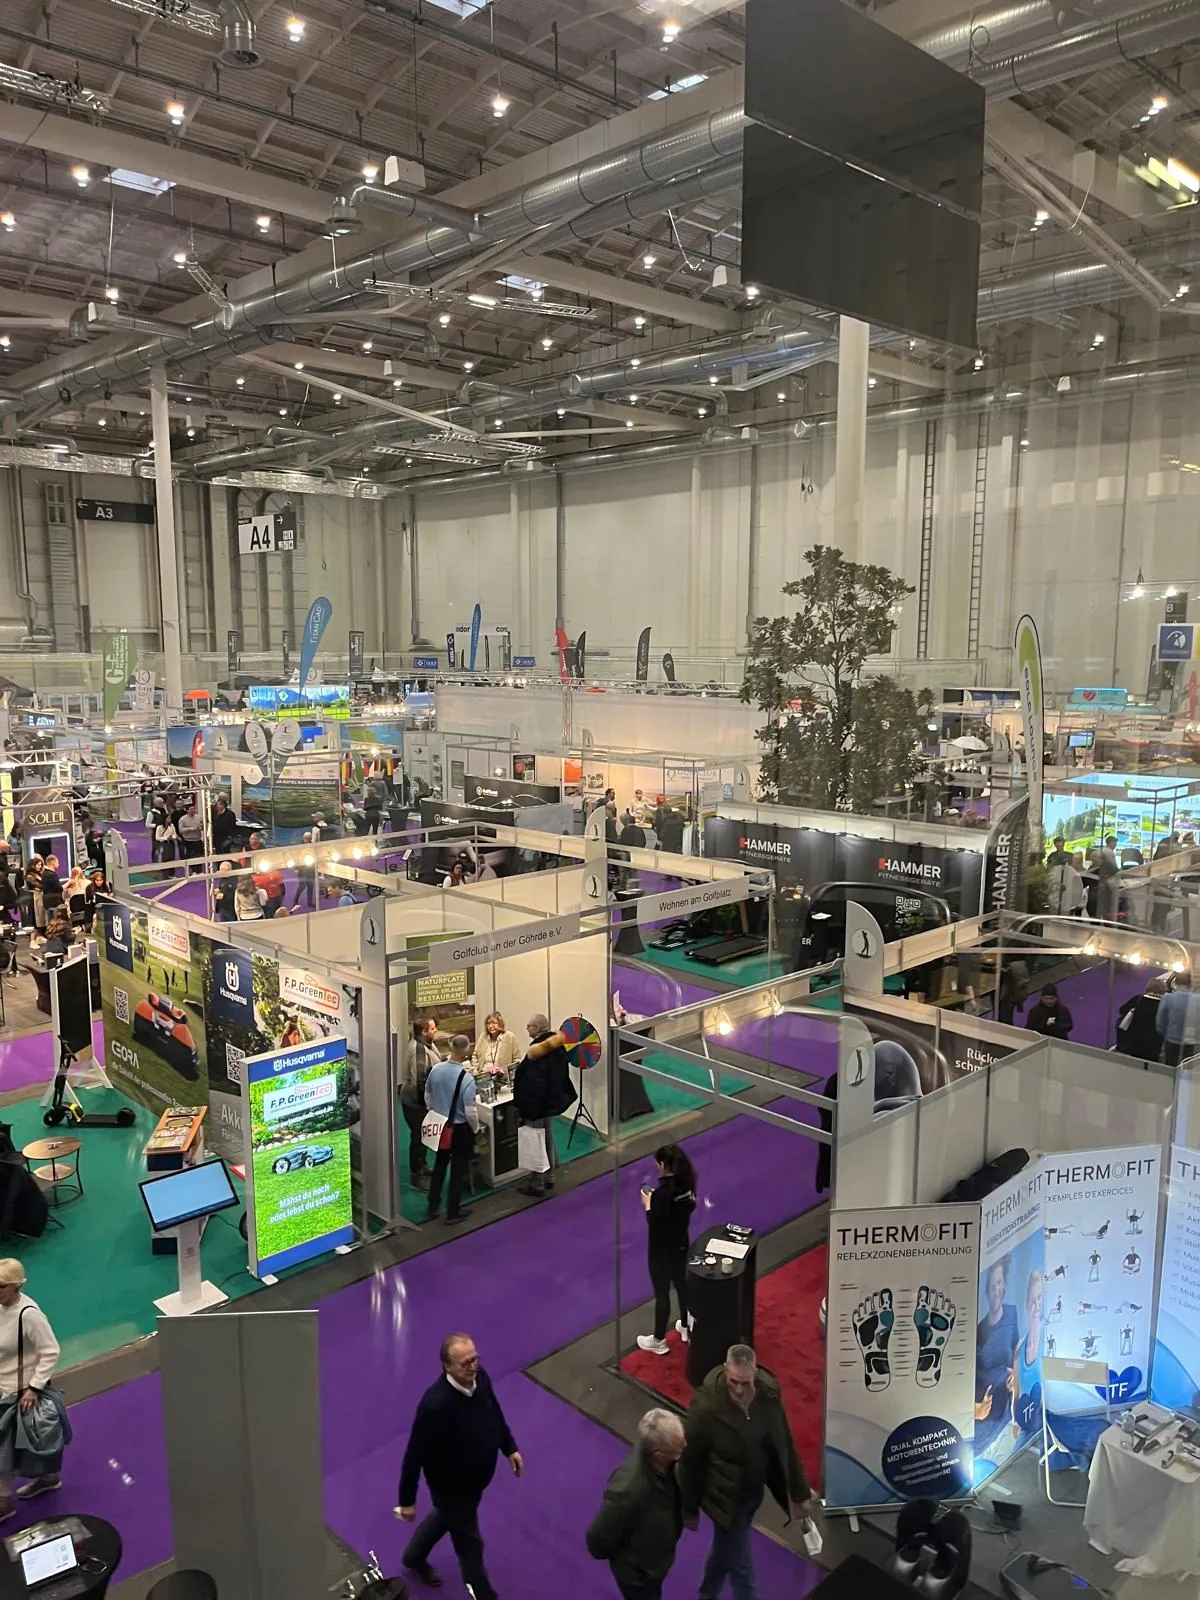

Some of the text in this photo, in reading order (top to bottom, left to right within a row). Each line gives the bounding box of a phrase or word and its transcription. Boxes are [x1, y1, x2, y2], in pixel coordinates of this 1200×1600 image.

[96, 506, 114, 519] A3
[250, 525, 270, 550] A4
[29, 811, 68, 825] SOLEIL
[739, 836, 791, 856] HAMMER
[878, 857, 941, 879] HAMMER
[659, 888, 732, 912] Wohnen am Golfplatz
[452, 945, 489, 961] Golfclub
[490, 943, 501, 952] an
[503, 938, 517, 950] der
[518, 930, 548, 945] Göhrde
[284, 976, 338, 1005] F.P.GreenTec
[418, 974, 466, 987] NATURPLATZ
[219, 986, 248, 1006] Husqvarna
[418, 989, 439, 997] HUNDE
[418, 991, 465, 1004] RESTAURANT
[282, 1049, 326, 1068] Husqvarna
[270, 1085, 331, 1109] F.P.GreenTec
[1044, 1159, 1157, 1186] THERMOFIT
[279, 1184, 330, 1208] Mähst du noch
[1084, 1186, 1135, 1199] D'EXERCICES
[269, 1212, 287, 1224] oder
[305, 1201, 315, 1210] du
[315, 1190, 340, 1206] schon?
[836, 1221, 974, 1246] THERMOFIT
[836, 1245, 973, 1262] REFLEXZONENBEHANDLUNG
[1109, 1382, 1129, 1399] TF
[1022, 1401, 1035, 1423] TF
[886, 1435, 958, 1463] MOTORENTECHNIK
[890, 1428, 949, 1453] DUAL KOMPAKT
[936, 1452, 949, 1461] und
[941, 1458, 960, 1467] einem
